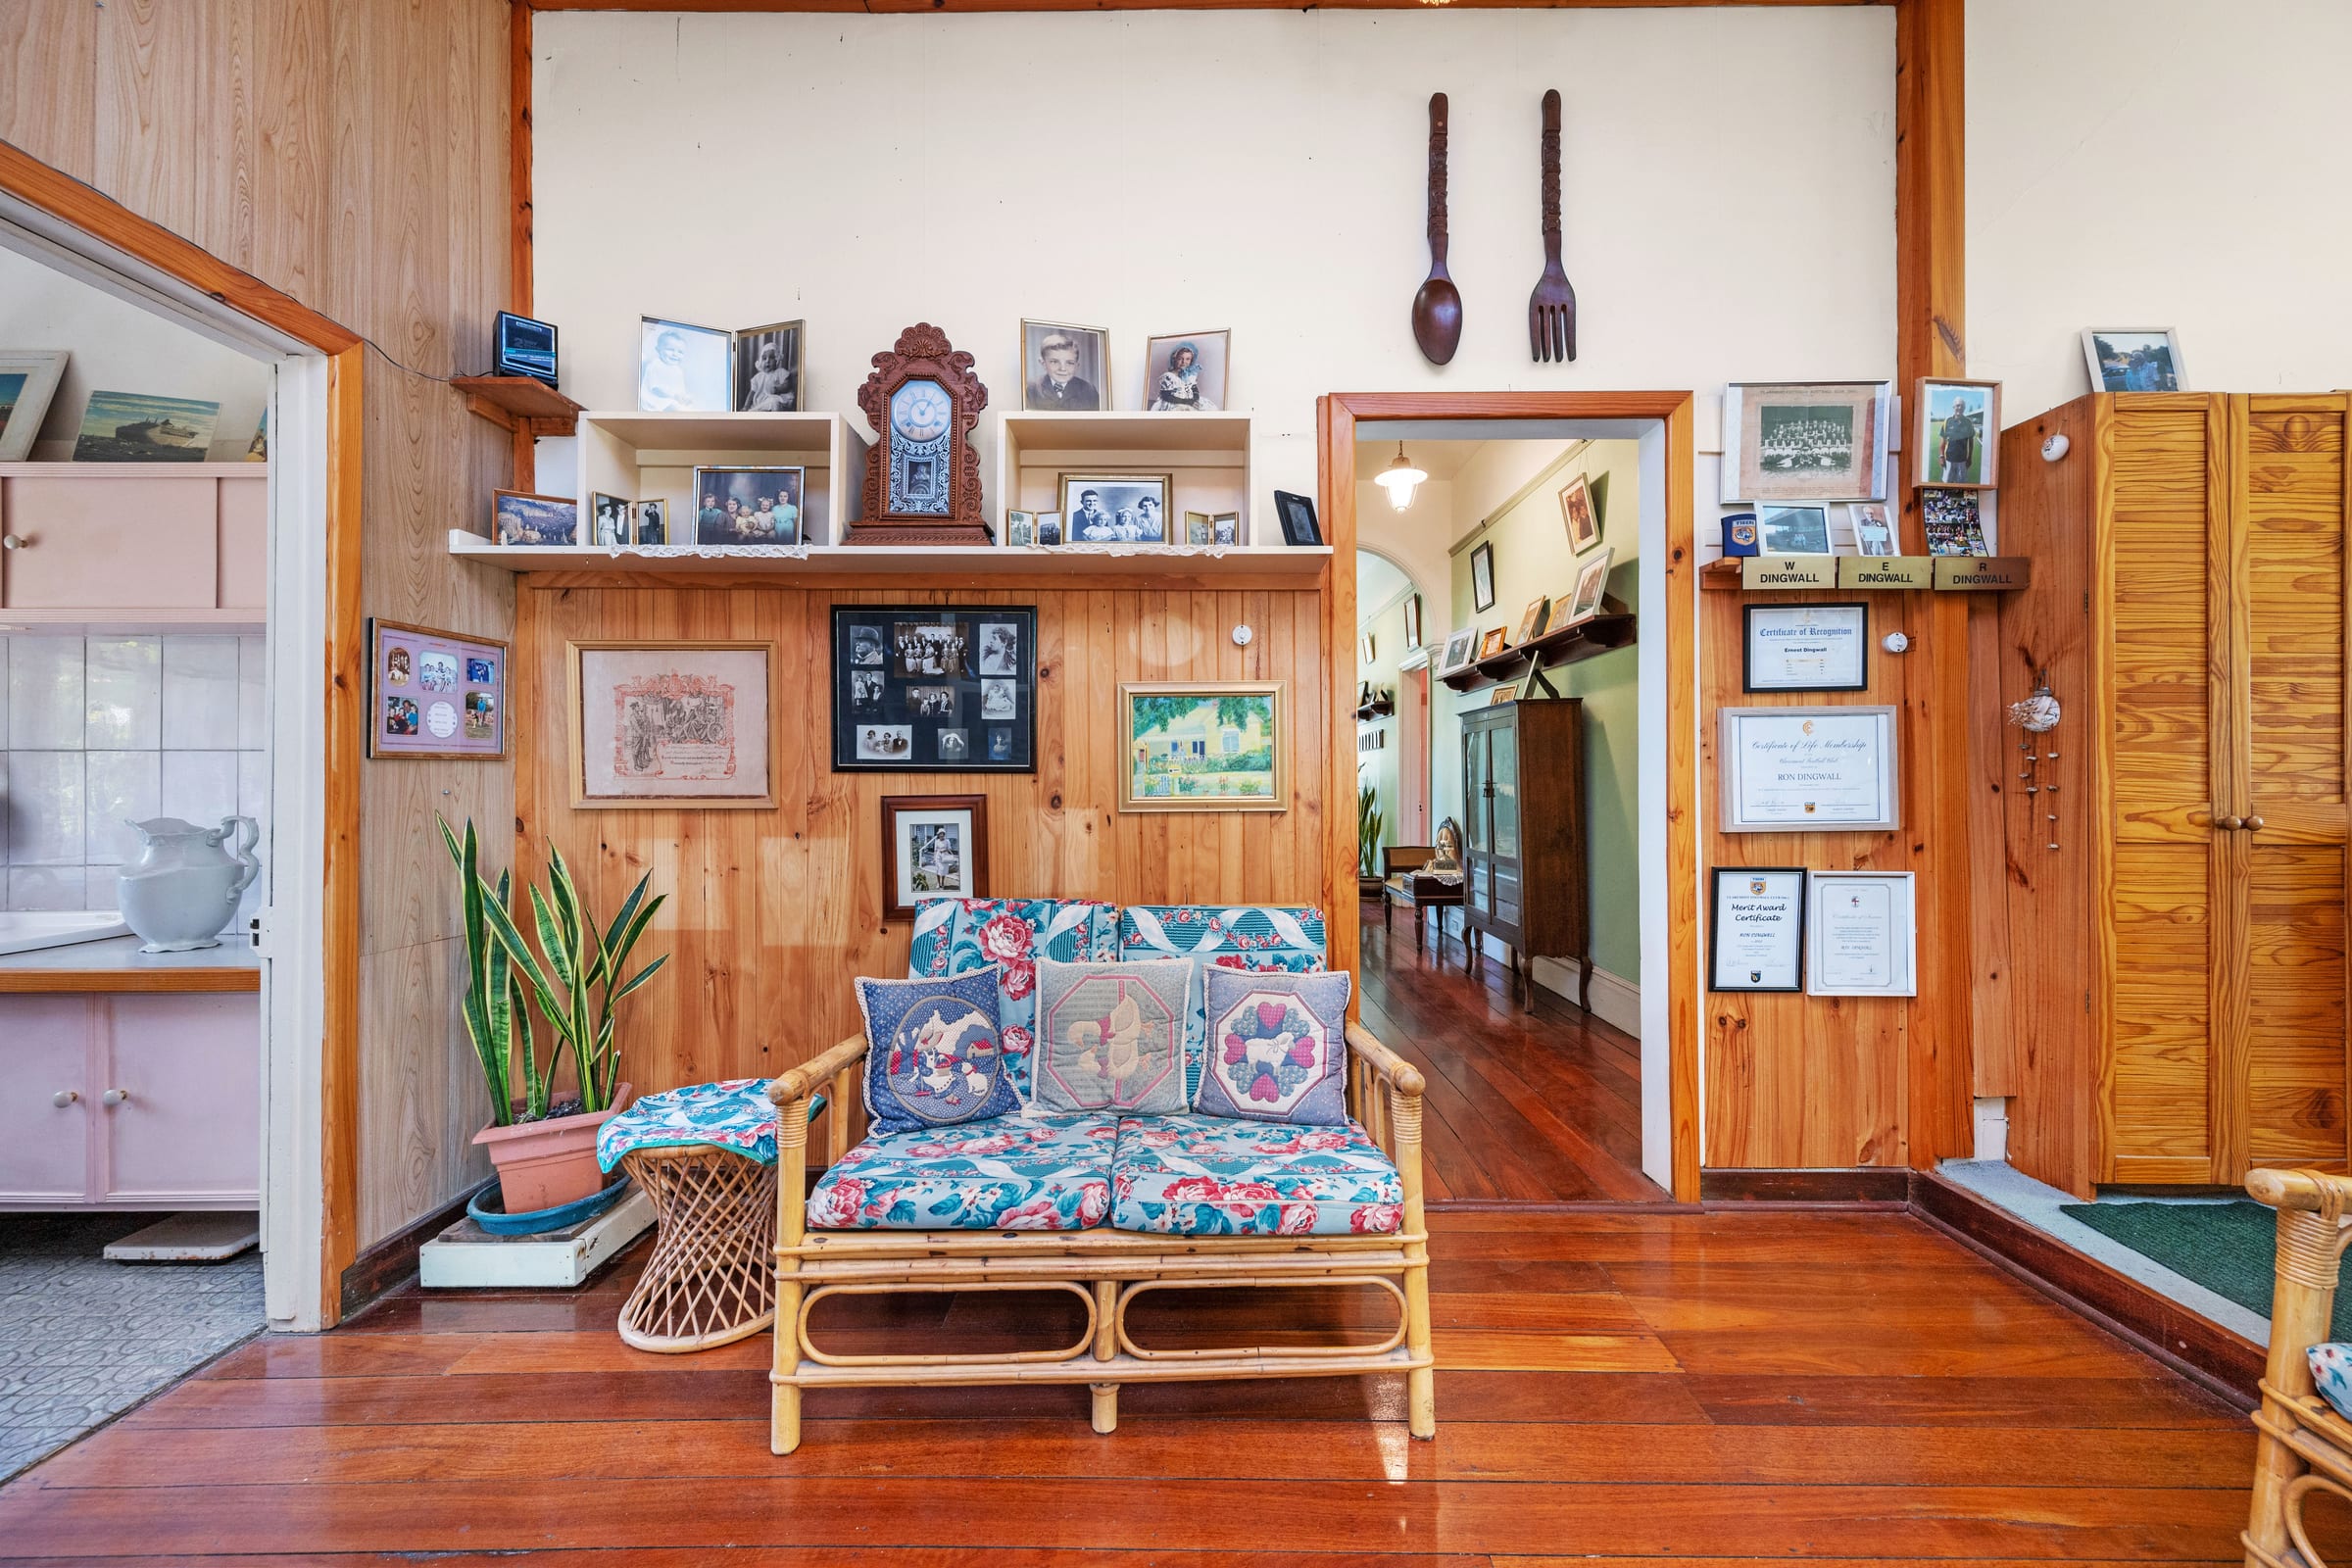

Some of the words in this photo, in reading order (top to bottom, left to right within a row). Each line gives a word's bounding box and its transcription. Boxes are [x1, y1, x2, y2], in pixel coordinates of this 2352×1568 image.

[1785, 562, 1795, 570] W
[1882, 562, 1889, 571] E
[1979, 563, 1987, 571] R
[1760, 573, 1820, 583] DINGWALL
[1858, 573, 1913, 583] DINGWALL
[1953, 574, 2012, 584] DINGWALL
[1759, 627, 1796, 637] Certificate
[1798, 627, 1808, 636] of
[1809, 627, 1852, 637] Recognition
[1751, 741, 1788, 753] Certificate
[1801, 739, 1819, 753] Life
[1820, 738, 1867, 753] Membership
[1797, 772, 1841, 781] DINGWALL
[1756, 903, 1787, 911] Award
[1735, 913, 1783, 923] Certificate
